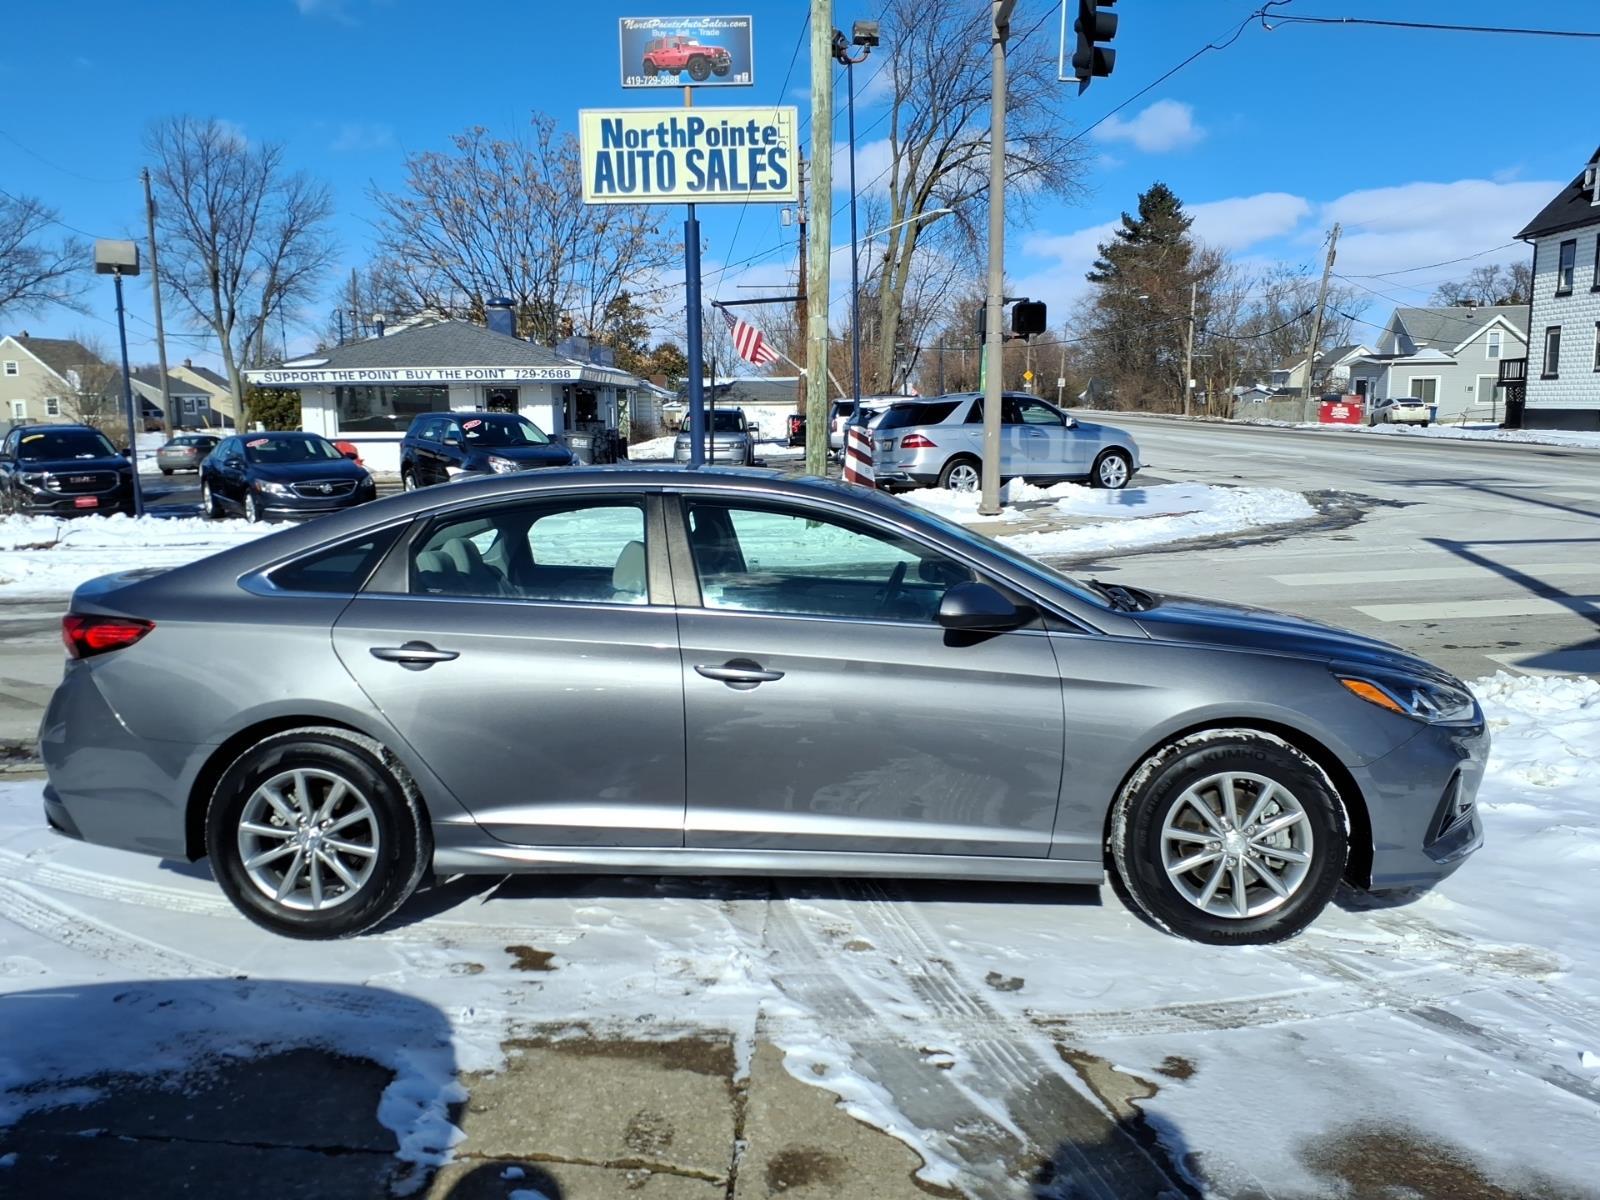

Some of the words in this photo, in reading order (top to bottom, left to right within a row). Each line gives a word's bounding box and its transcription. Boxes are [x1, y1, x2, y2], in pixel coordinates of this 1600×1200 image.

[624, 18, 748, 30] NorthPointeAutoSales.com
[651, 29, 667, 37] Buy
[700, 28, 720, 36] Trade
[626, 75, 680, 85] 419-729-2688
[600, 117, 777, 149] NorthPointe
[594, 149, 676, 194] AUTO
[685, 147, 788, 192] SALES
[264, 371, 326, 383] SUPPORT
[331, 370, 355, 381] THE
[359, 370, 400, 380] POINT
[405, 369, 433, 380] BUY
[437, 369, 462, 379] THE
[465, 368, 506, 379] POINT
[514, 369, 571, 379] 729-2688
[1202, 749, 1267, 763] KUMHO
